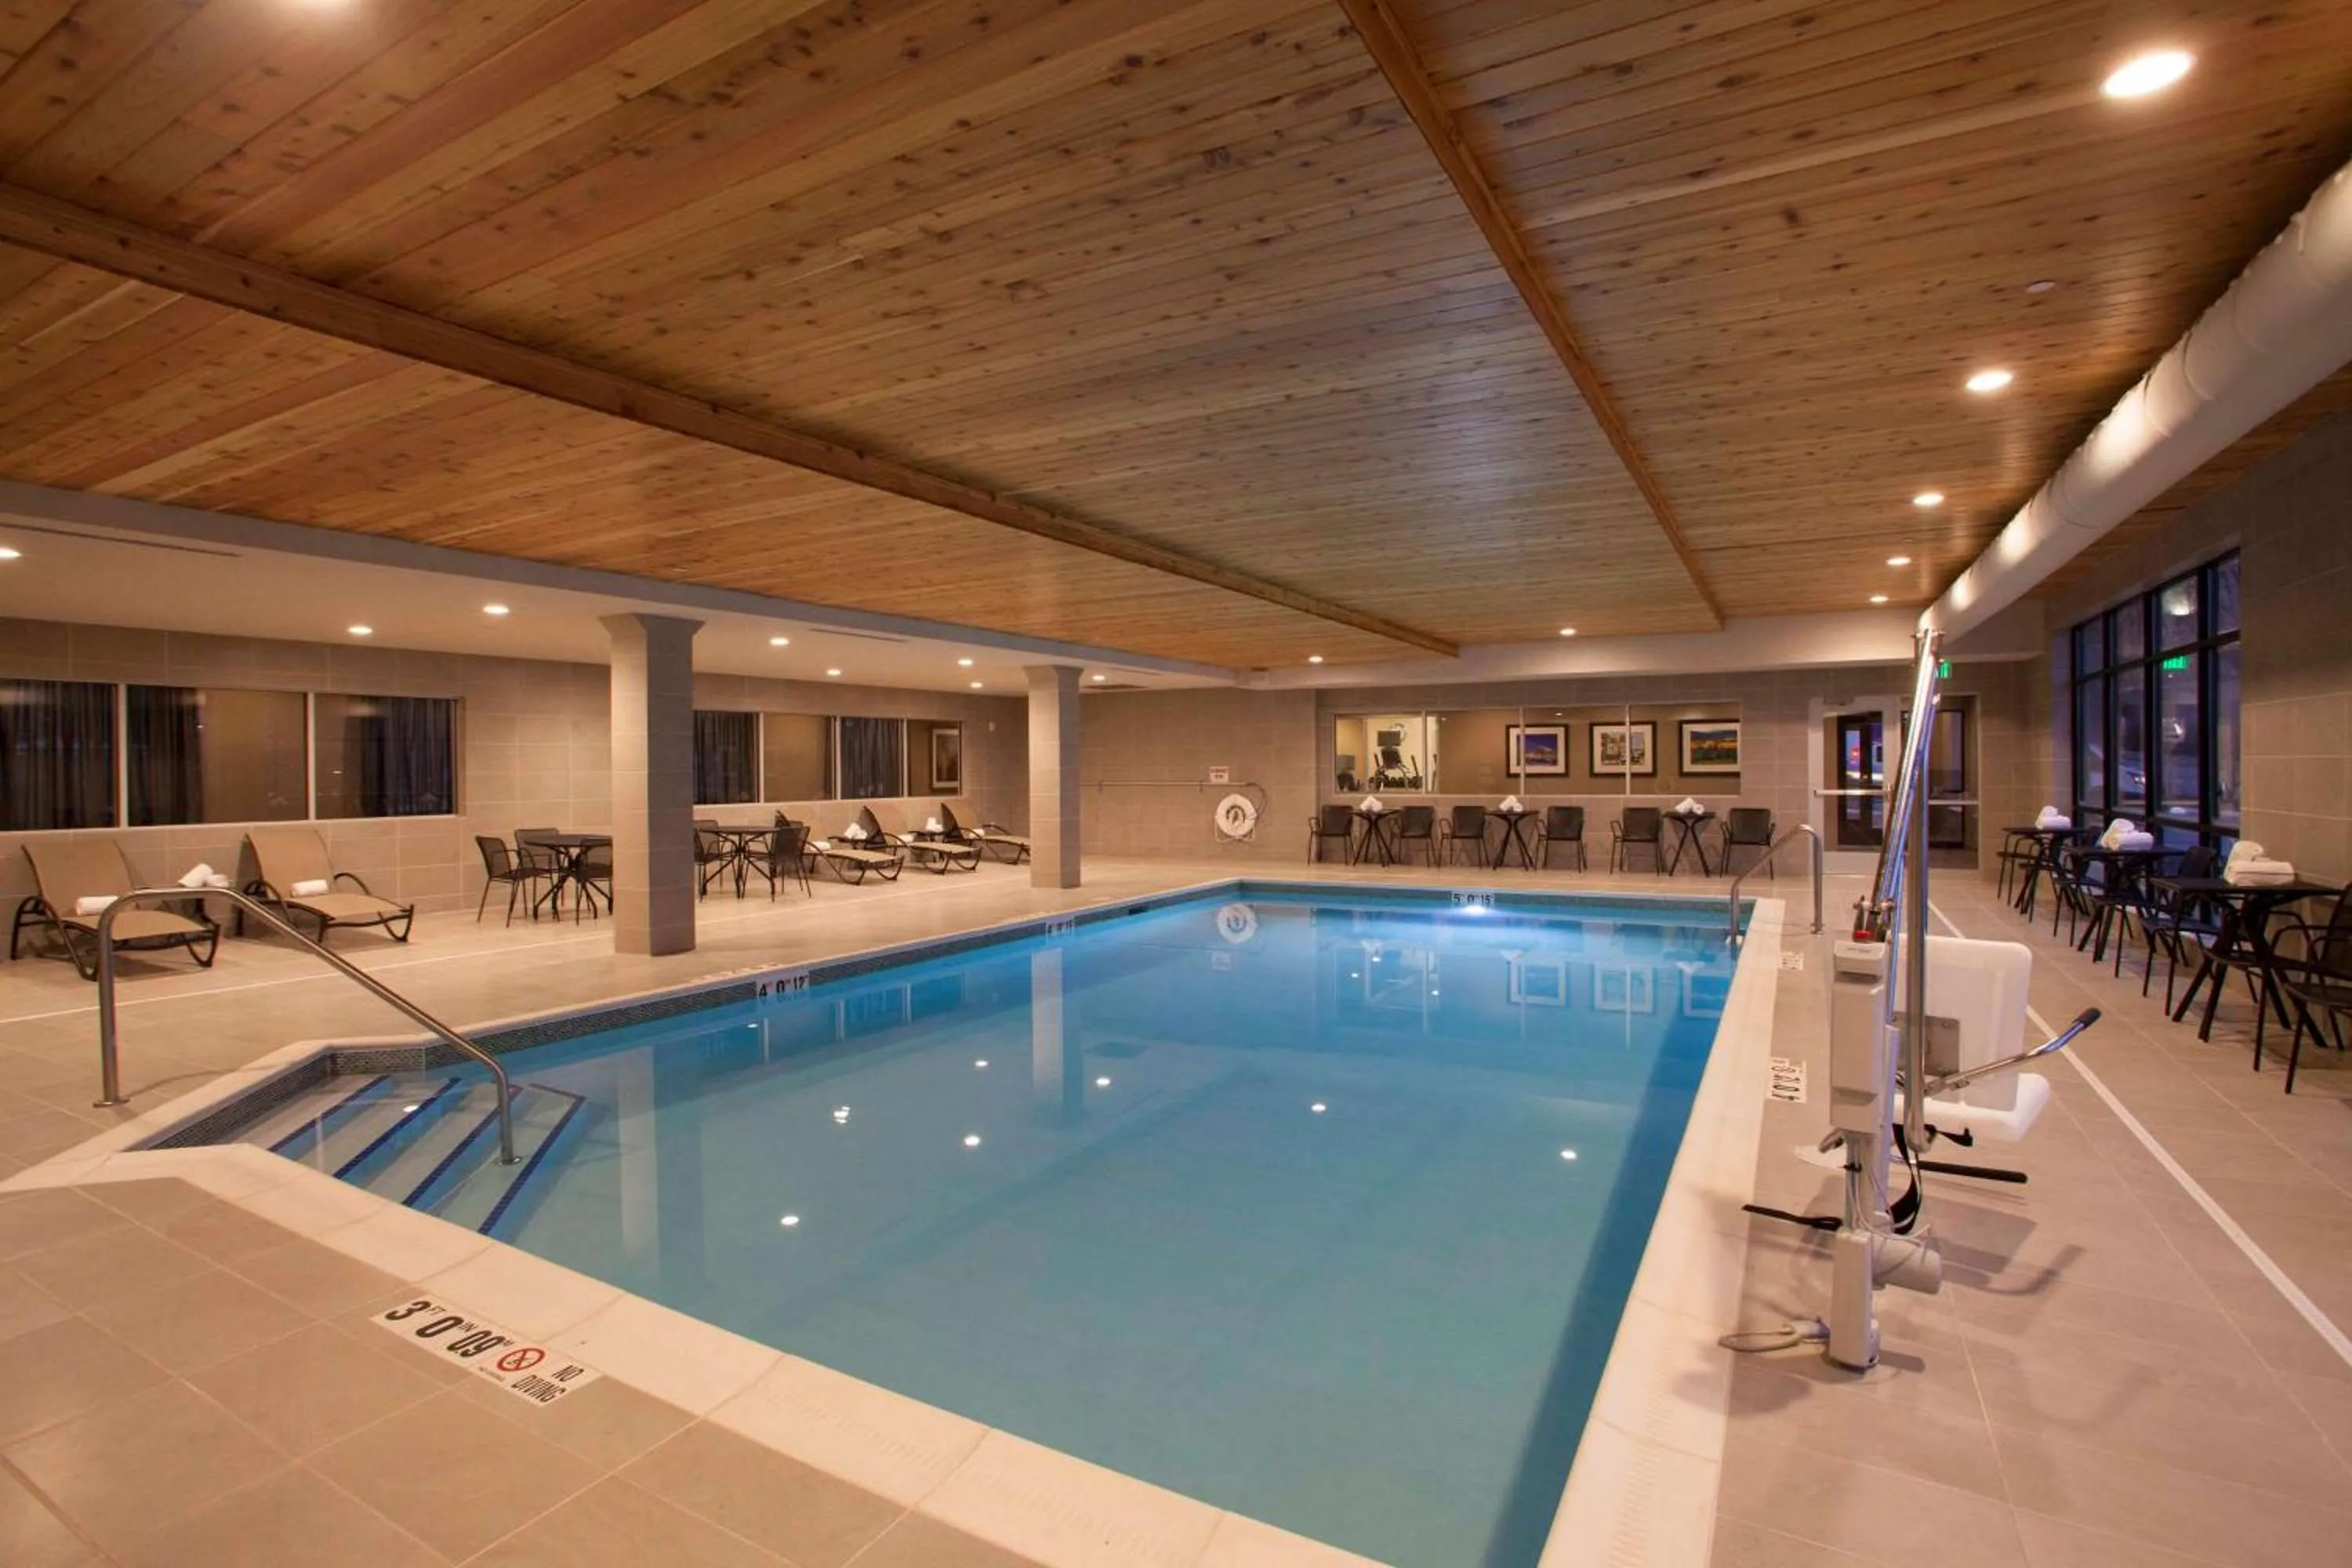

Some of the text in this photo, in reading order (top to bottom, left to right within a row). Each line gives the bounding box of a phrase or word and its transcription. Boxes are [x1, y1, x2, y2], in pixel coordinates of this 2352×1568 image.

[385, 1301, 431, 1320] 3
[415, 1316, 464, 1338] 0
[551, 1365, 584, 1382] NO
[510, 1374, 566, 1402] DIVING
